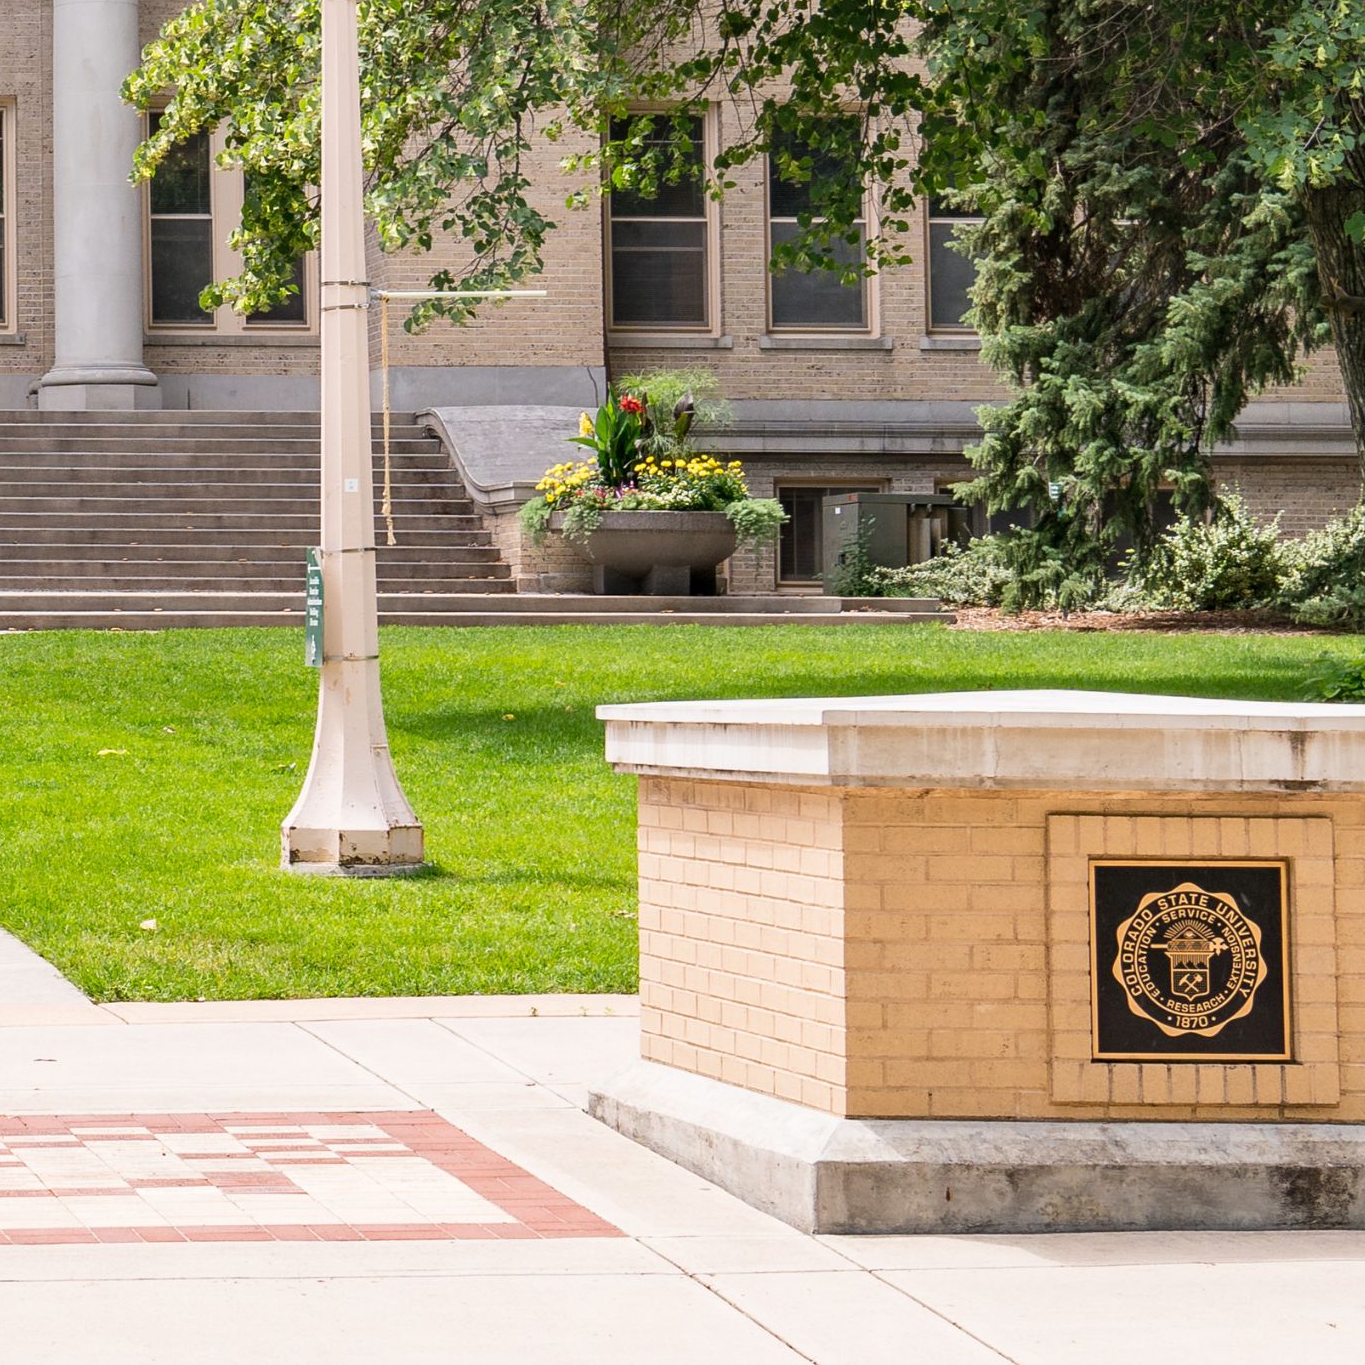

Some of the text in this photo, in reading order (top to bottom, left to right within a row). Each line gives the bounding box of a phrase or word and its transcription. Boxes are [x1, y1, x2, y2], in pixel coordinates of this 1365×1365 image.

[1162, 909, 1216, 924] SERVICE
[1122, 893, 1259, 998] COLORADO STATE UNIVERSITY
[1138, 926, 1161, 998] EDUCATION
[1222, 927, 1242, 993] EXTENSION
[1166, 993, 1225, 1013] RESEARCH
[1175, 1016, 1209, 1029] 1870
